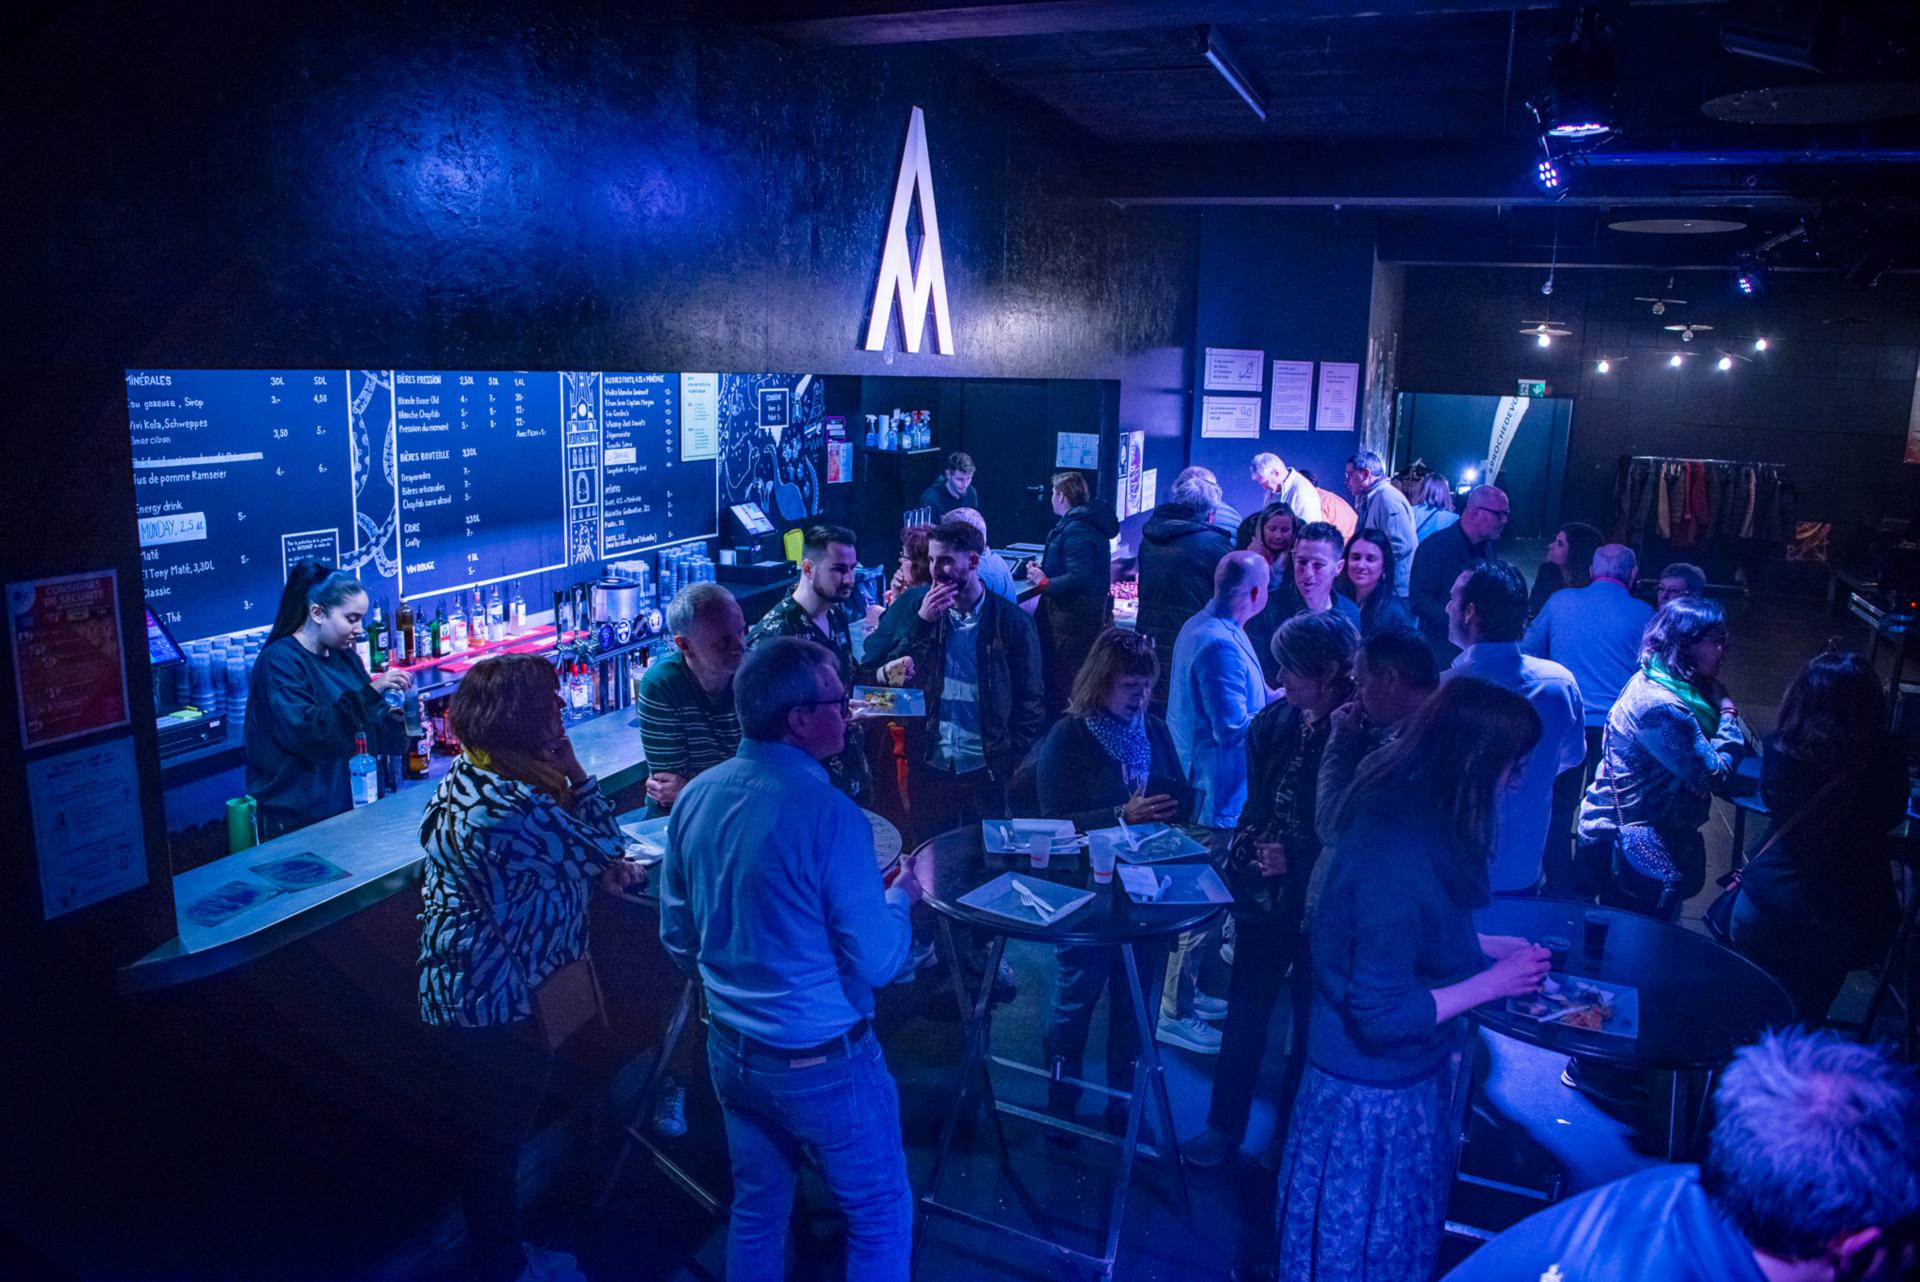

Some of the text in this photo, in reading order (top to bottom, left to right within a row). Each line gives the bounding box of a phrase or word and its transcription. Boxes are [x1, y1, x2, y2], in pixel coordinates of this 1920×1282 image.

[184, 396, 204, 409] Sirop
[273, 429, 288, 440] 3,50
[149, 472, 159, 484] de
[160, 474, 190, 486] pomme
[192, 468, 226, 480] Ramseier
[164, 500, 183, 511] drink
[148, 568, 168, 580] Tony
[170, 563, 193, 576] Maté,
[194, 560, 216, 574] 3,3DL
